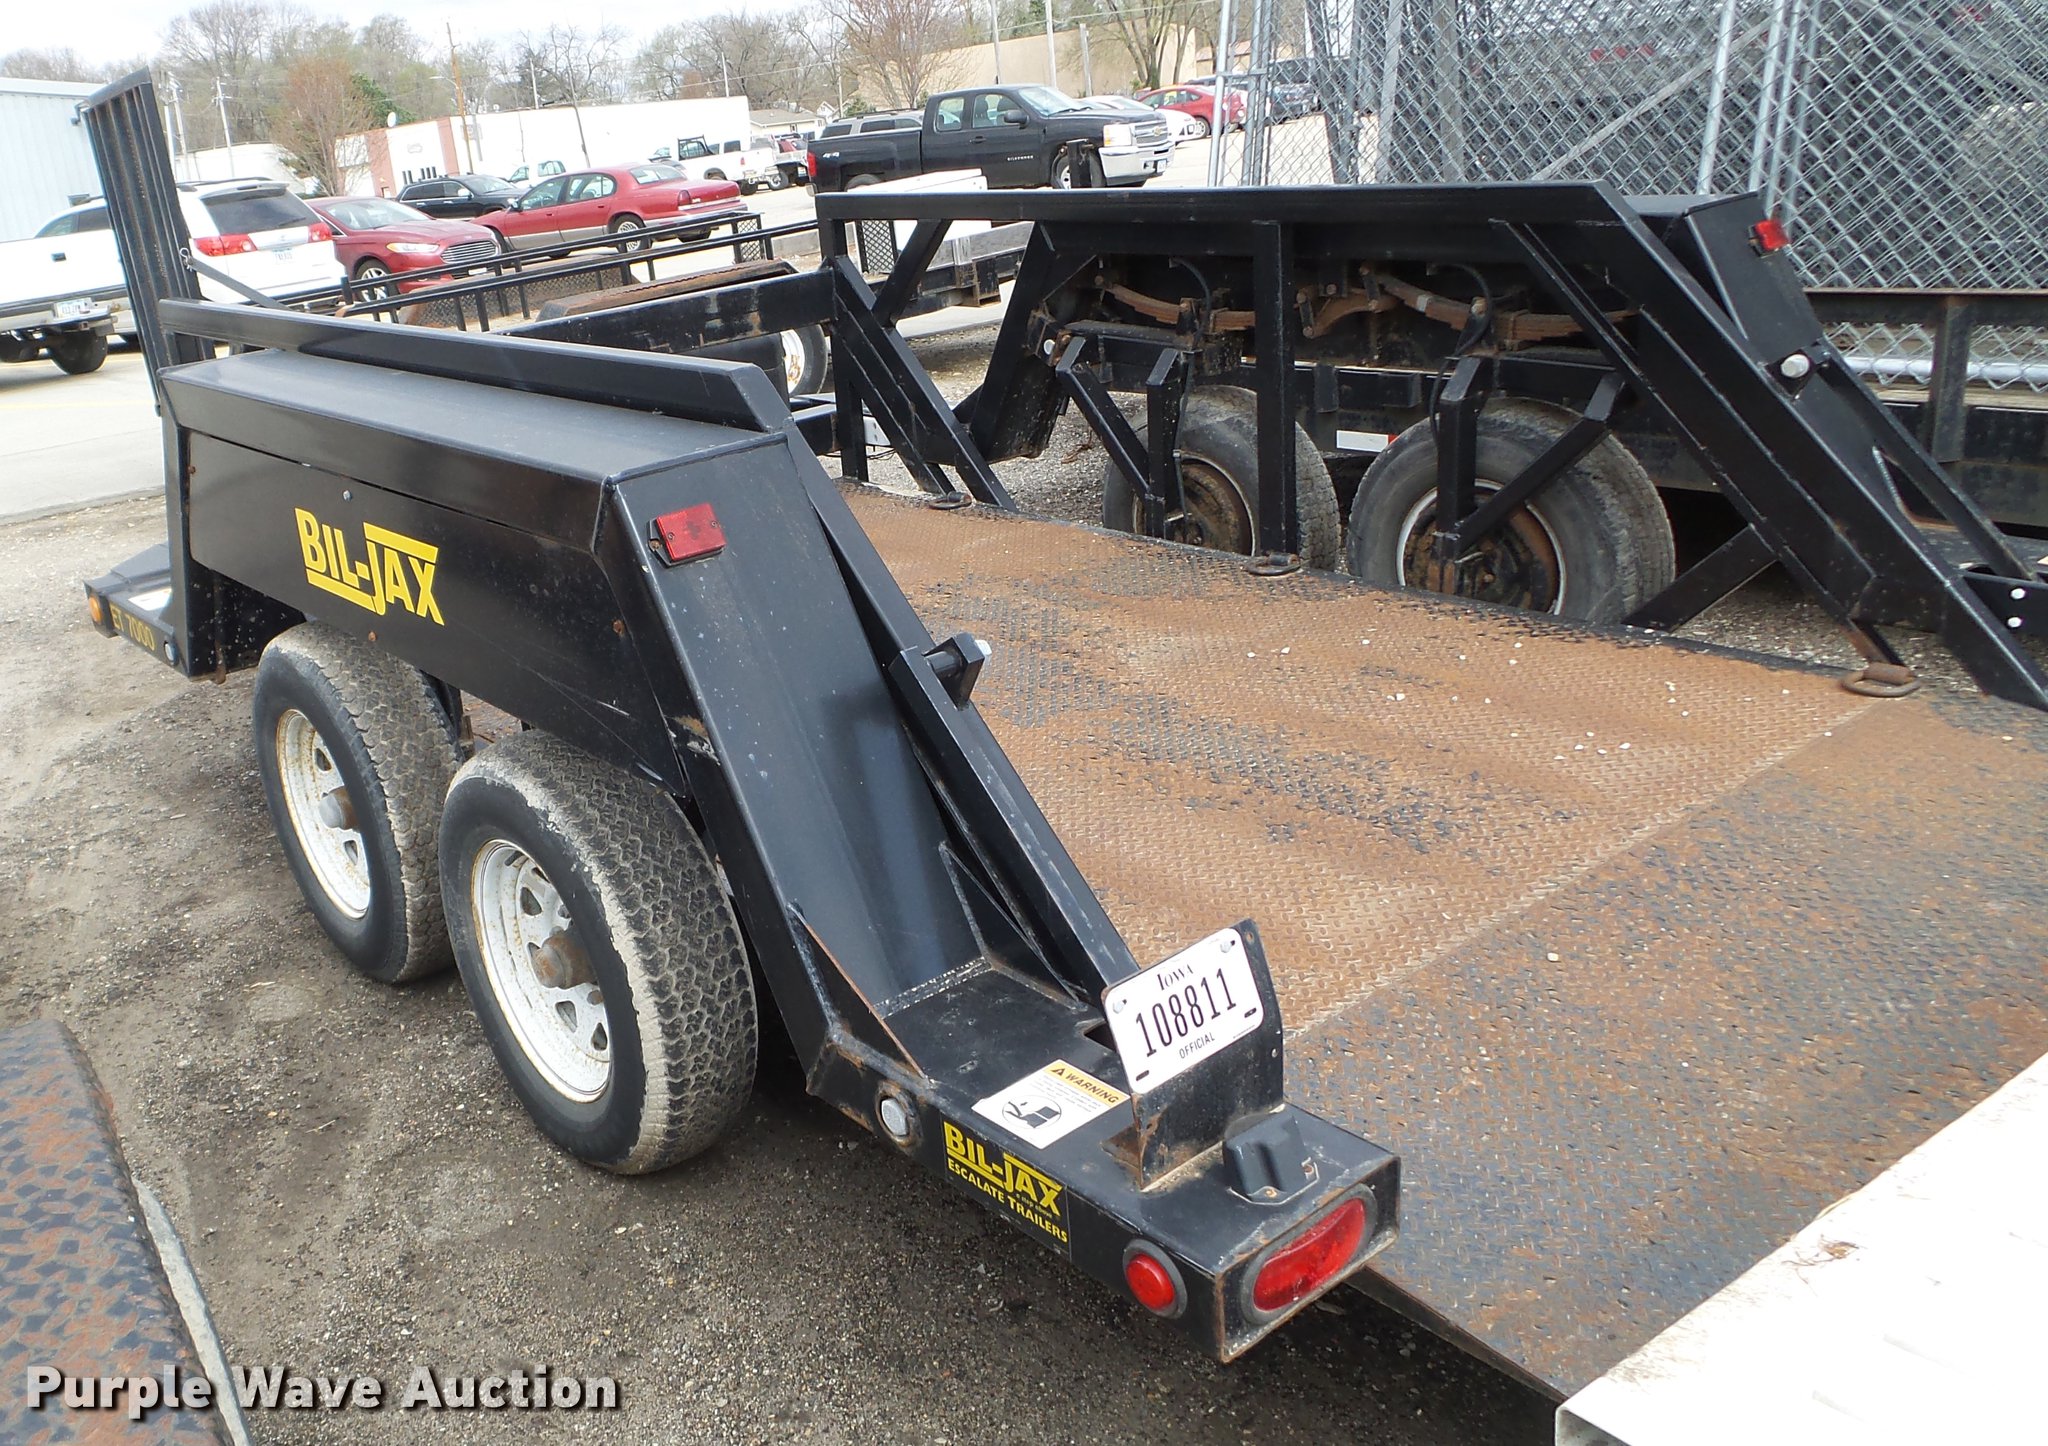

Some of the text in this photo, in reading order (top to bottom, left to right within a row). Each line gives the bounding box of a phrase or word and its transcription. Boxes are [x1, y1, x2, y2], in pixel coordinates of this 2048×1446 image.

[294, 507, 445, 626] BIL-JAX
[109, 603, 124, 632] ET
[1135, 968, 1237, 1057] 108811
[1178, 1032, 1216, 1059] OFFICIAL
[1065, 1073, 1120, 1105] WARNING
[943, 1120, 1063, 1217] BIL-JAX
[947, 1158, 1068, 1243] ESCALATE TRAILERS
